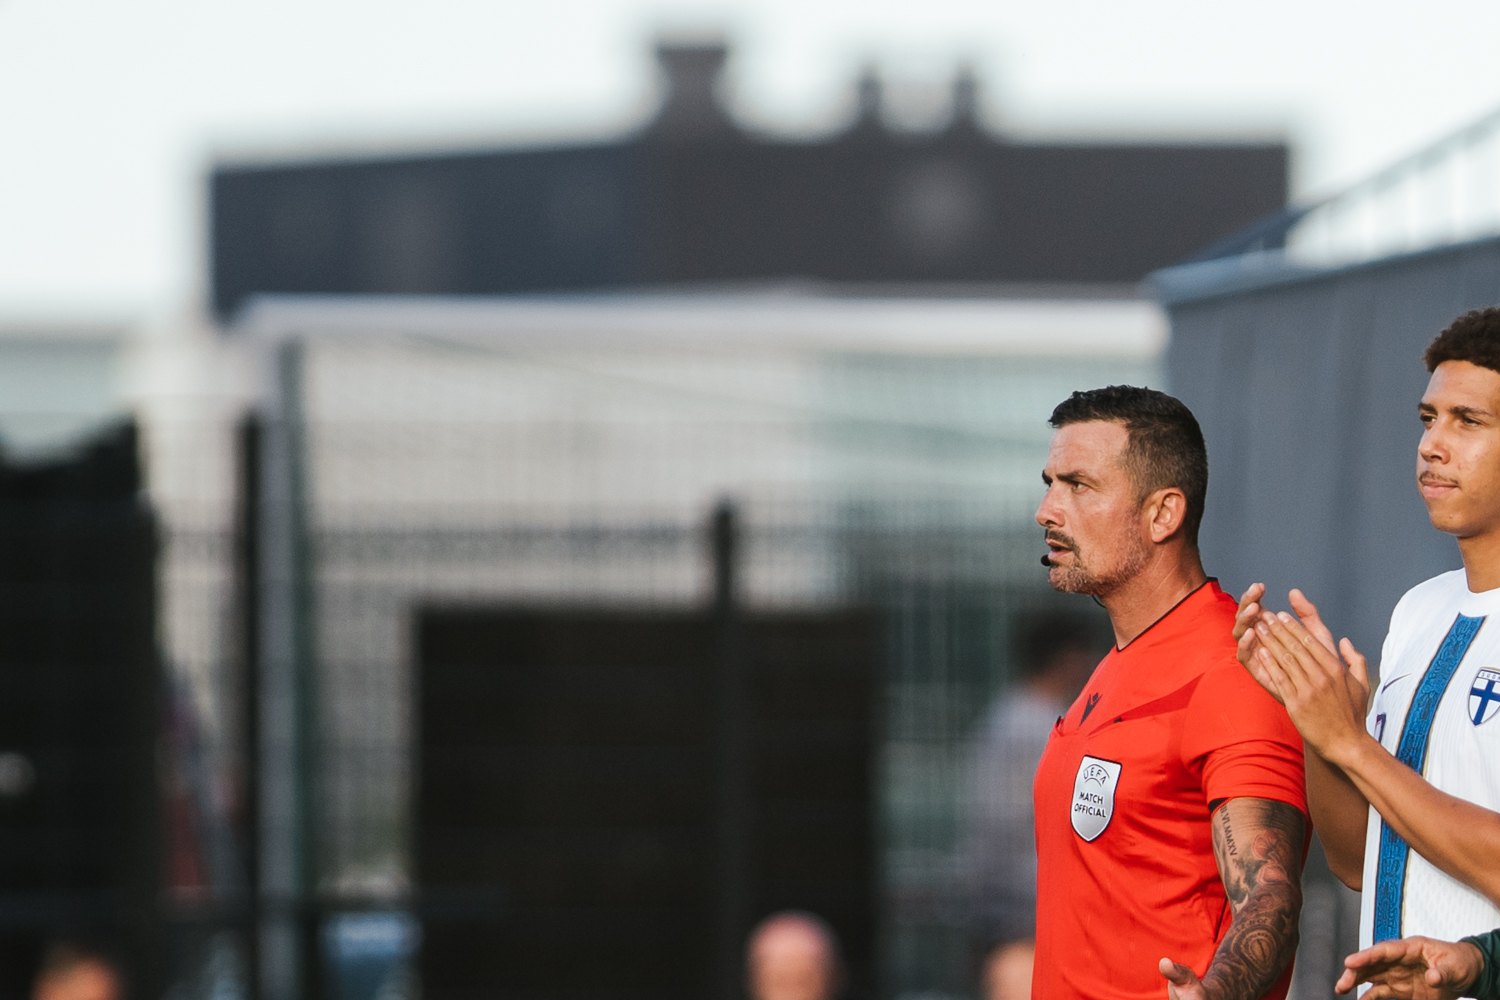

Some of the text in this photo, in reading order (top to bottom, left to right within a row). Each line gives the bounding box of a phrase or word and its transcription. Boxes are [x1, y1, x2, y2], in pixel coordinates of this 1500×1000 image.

[1083, 766, 1107, 785] UEFA
[1079, 791, 1104, 805] MATCH
[1074, 803, 1107, 818] OFFICIAL
